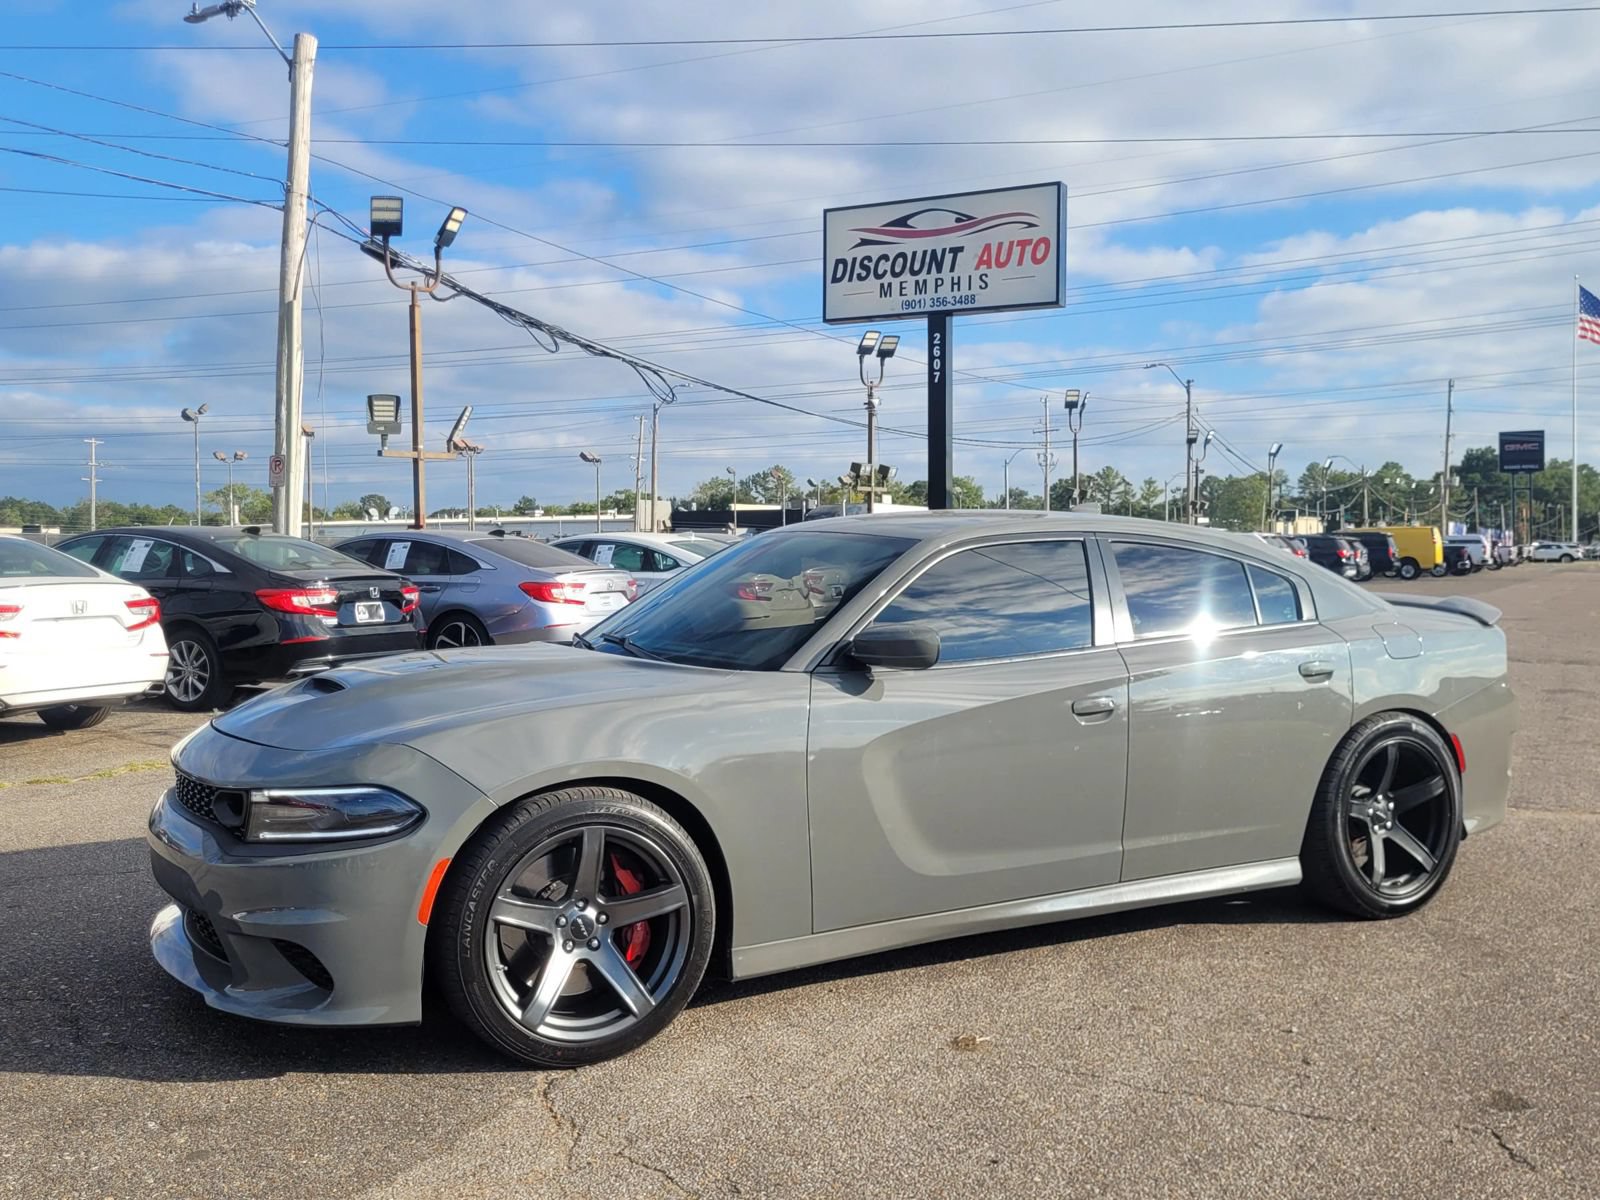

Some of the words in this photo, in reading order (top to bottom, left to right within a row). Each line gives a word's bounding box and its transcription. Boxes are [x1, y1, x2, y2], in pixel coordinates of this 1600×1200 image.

[831, 246, 965, 284] DISCOUNT
[974, 236, 1051, 271] AUTO
[879, 273, 989, 298] MEMPHIS
[901, 299, 926, 311] (901)
[929, 294, 976, 308] 356-3488
[933, 332, 941, 383] 2607
